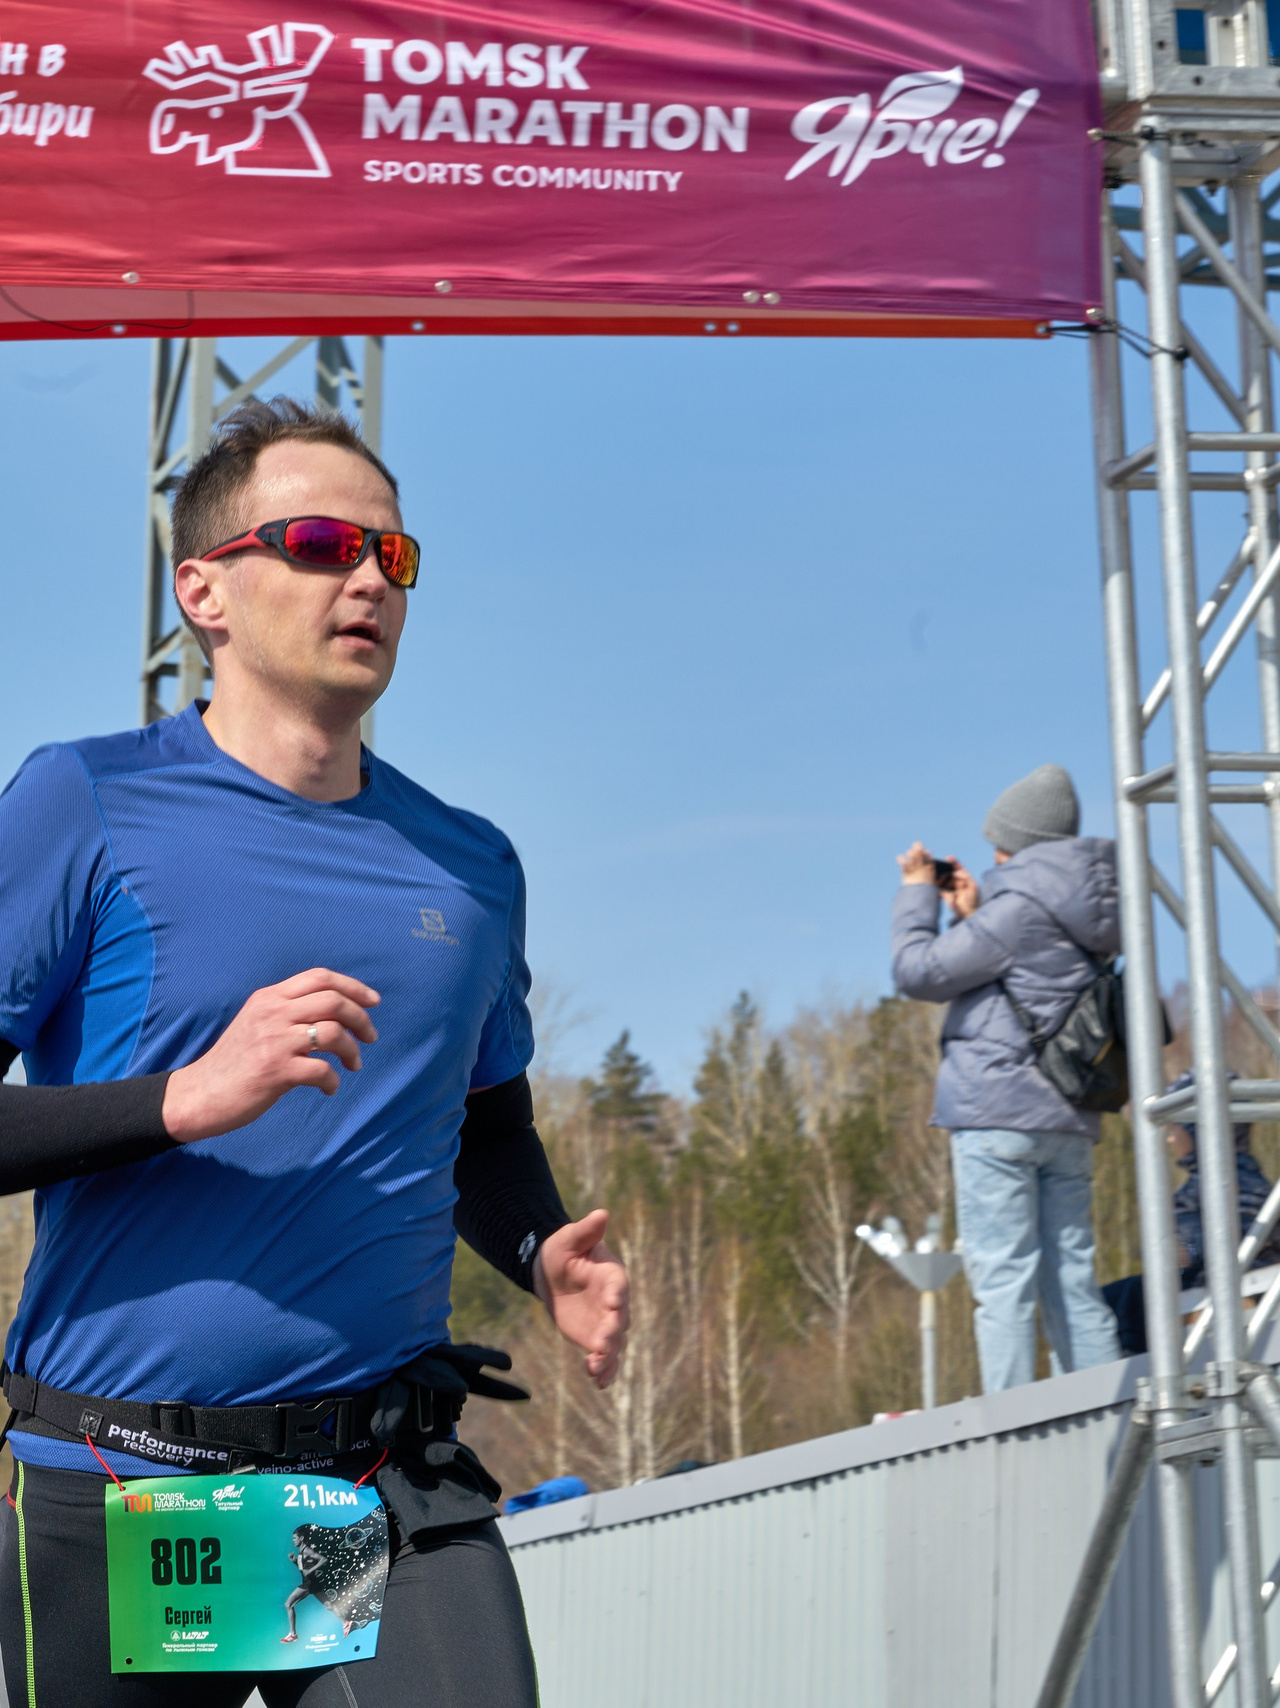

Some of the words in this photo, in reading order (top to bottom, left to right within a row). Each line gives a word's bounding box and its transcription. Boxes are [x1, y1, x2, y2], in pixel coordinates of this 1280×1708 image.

[38, 43, 67, 77] в
[350, 37, 590, 91] TOMSK
[362, 92, 750, 153] MARATHON
[363, 159, 483, 186] SPORTS
[492, 164, 684, 193] COMMUNITY
[108, 1423, 228, 1462] performance
[123, 1439, 193, 1467] recovery
[257, 1457, 334, 1475] veino-active
[153, 1492, 185, 1501] TOMSK
[154, 1499, 206, 1508] MARATHON
[151, 1537, 222, 1586] 802
[165, 1605, 212, 1628] Сергей
